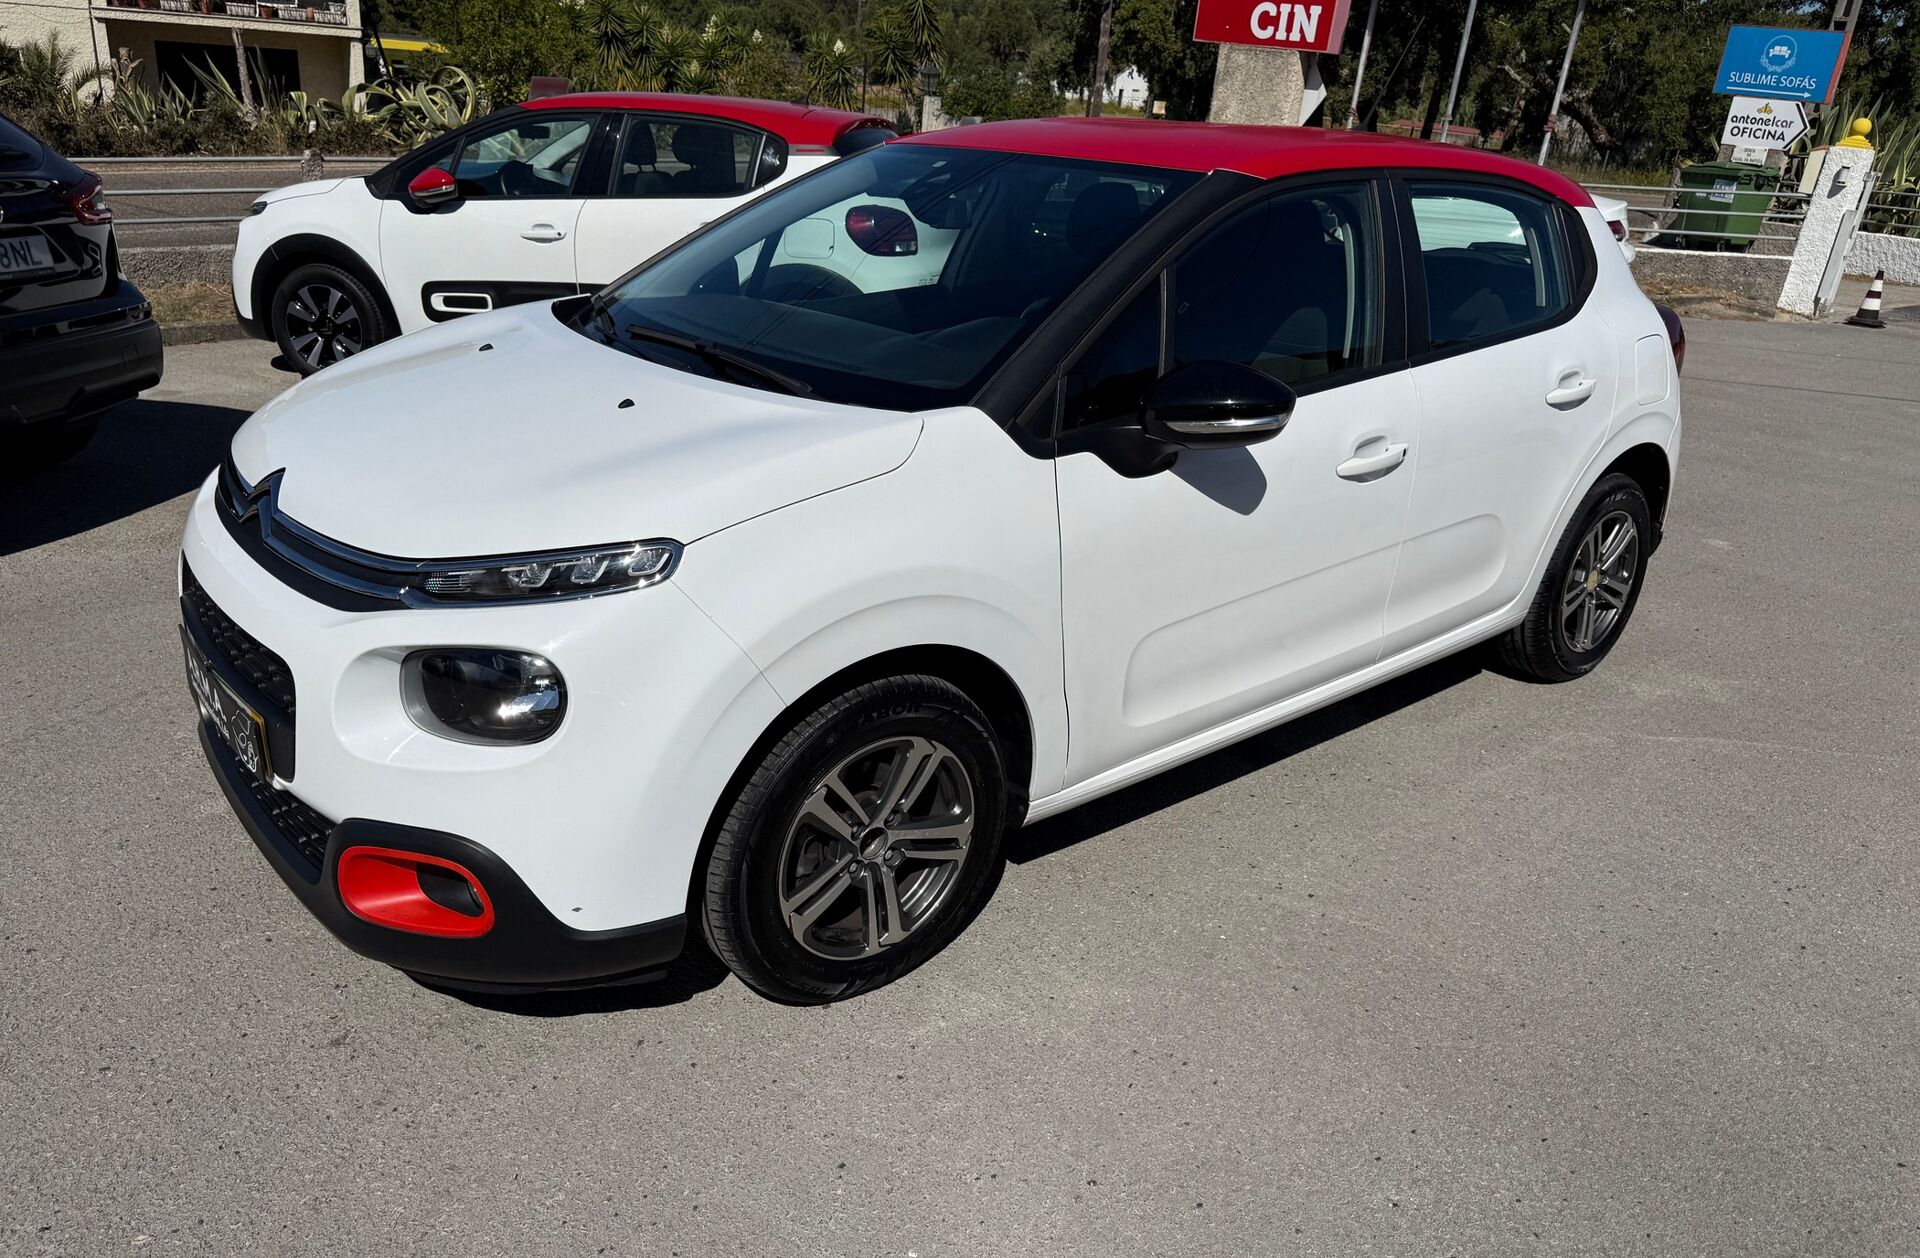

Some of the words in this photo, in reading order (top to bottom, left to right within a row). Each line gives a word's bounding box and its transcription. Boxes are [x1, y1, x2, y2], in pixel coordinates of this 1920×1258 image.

[1250, 2, 1322, 43] CIN
[1728, 71, 1777, 86] SUBLIME
[1780, 75, 1817, 89] SOFÁS
[1730, 114, 1794, 129] antonelcar
[1730, 125, 1786, 142] OFICINA
